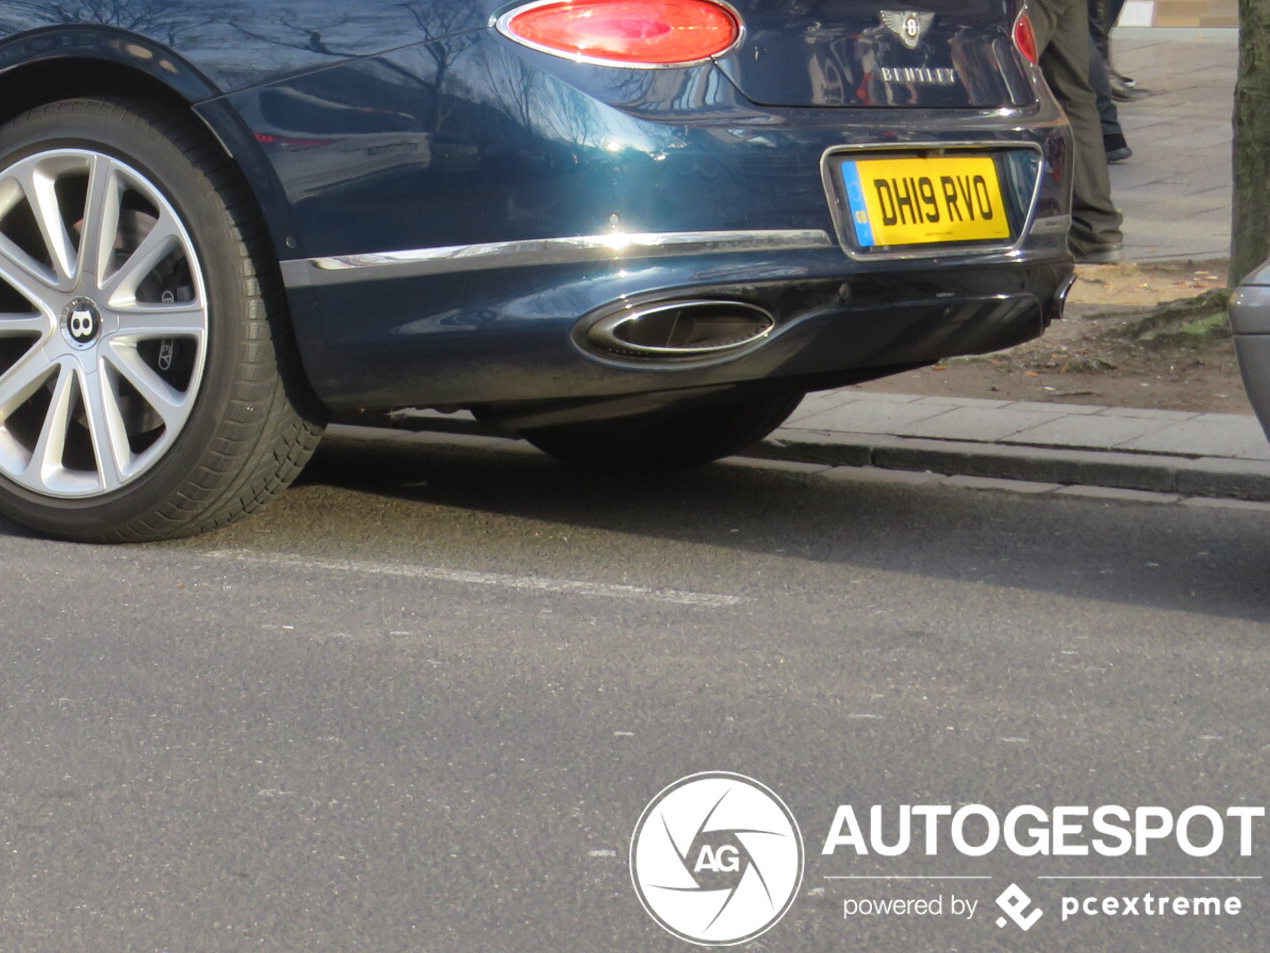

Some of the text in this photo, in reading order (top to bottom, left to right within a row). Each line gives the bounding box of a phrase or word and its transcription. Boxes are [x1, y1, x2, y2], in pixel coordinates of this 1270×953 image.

[881, 66, 955, 84] BENTLEY
[874, 175, 993, 226] DH19 RVO
